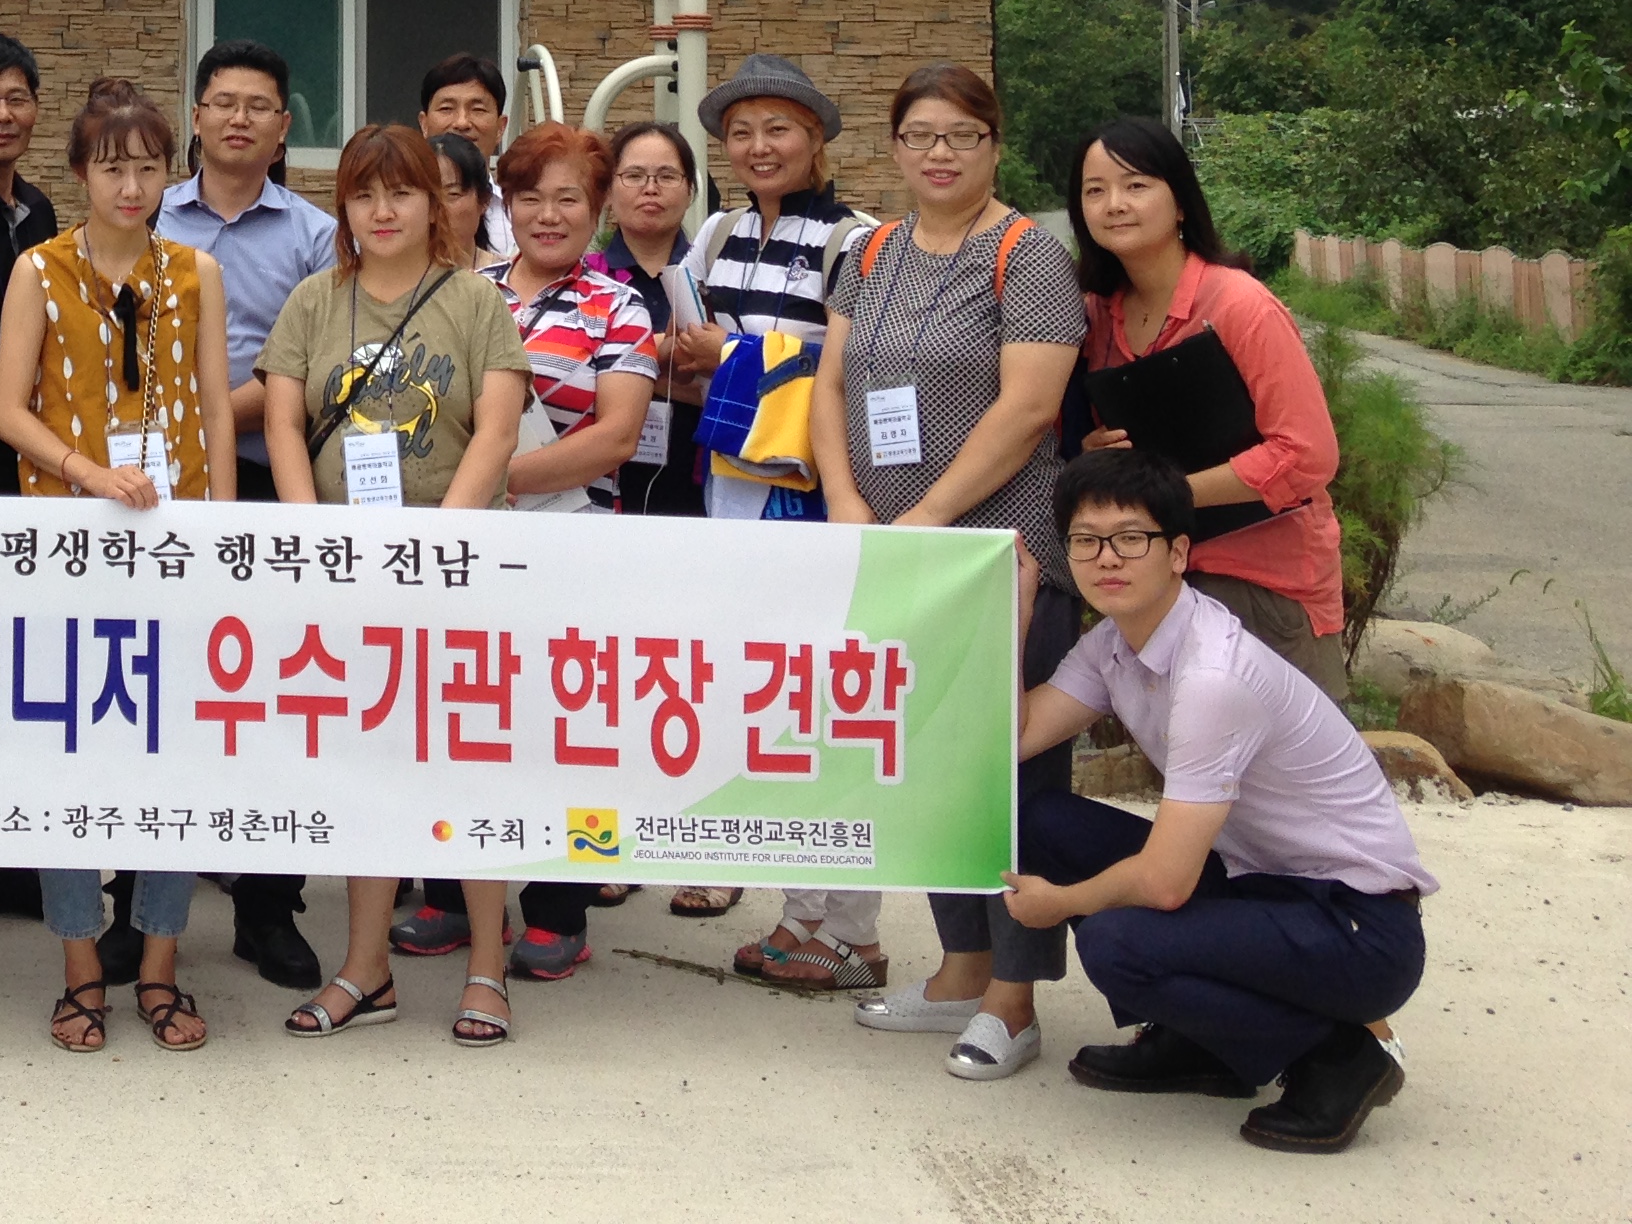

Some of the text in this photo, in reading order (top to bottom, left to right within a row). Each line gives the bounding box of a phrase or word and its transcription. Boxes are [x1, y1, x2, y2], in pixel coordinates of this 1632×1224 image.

[214, 532, 363, 584] 행복한
[381, 537, 480, 589] 전남
[194, 615, 522, 765] 우수기관
[547, 626, 714, 779] 현장
[742, 637, 908, 778] 견학
[61, 804, 127, 841] 광주
[133, 806, 199, 841] 북구
[207, 809, 336, 846] 평촌마을
[634, 816, 873, 849] 전라남도평생교육진흥원
[633, 849, 873, 865] JEOLLANAMDO INSTITUTE FOR LIFELONG EDUCATION
